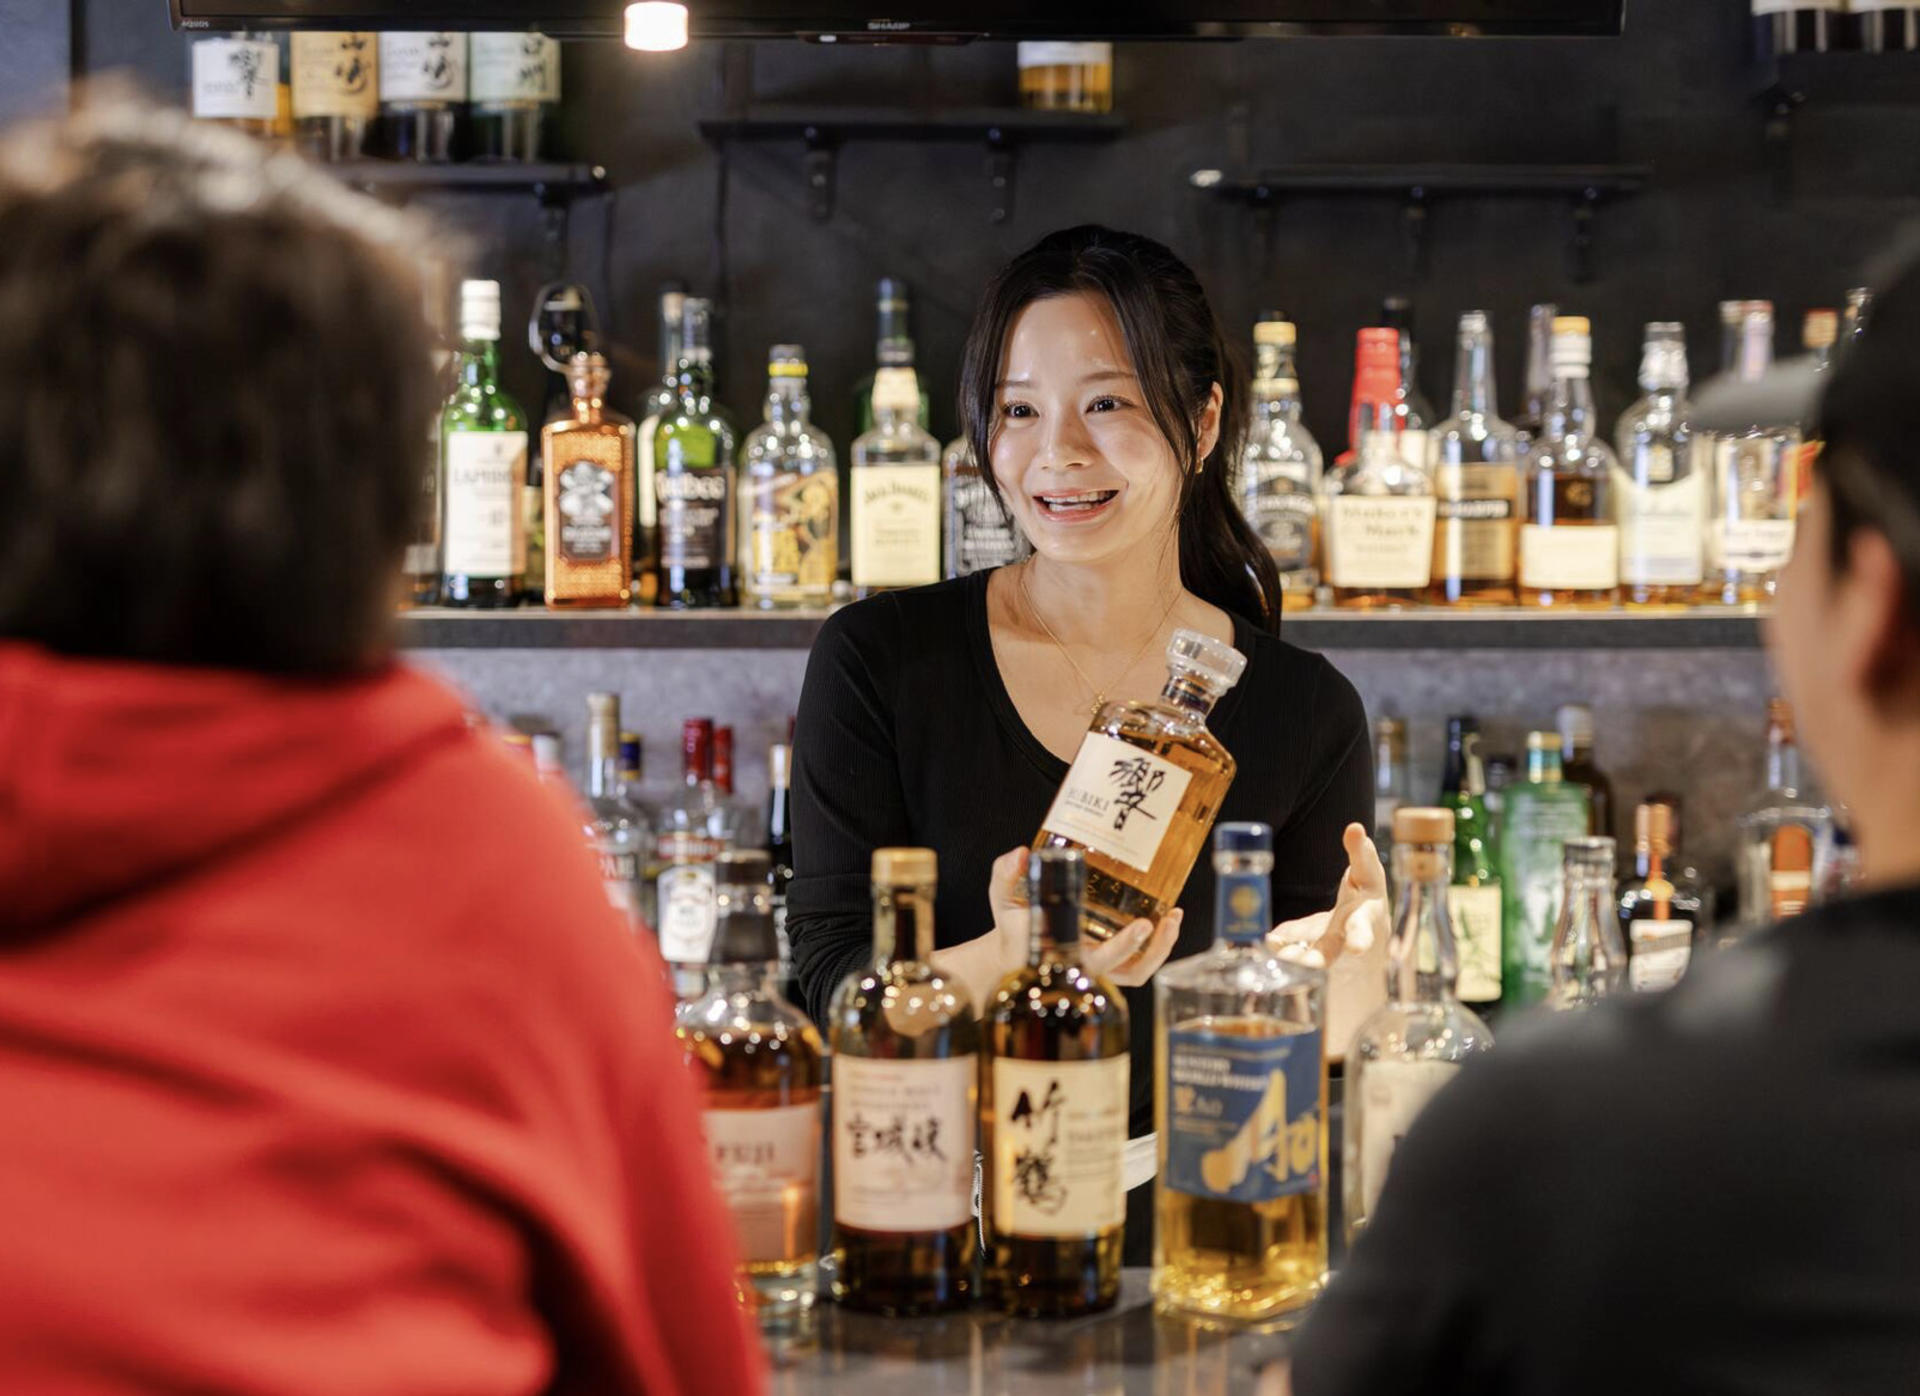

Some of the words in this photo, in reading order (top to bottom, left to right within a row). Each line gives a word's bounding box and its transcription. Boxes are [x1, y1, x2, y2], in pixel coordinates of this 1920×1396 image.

[867, 22, 910, 30] SHARP
[1109, 757, 1166, 832] 響
[1010, 1079, 1068, 1216] 竹鶴
